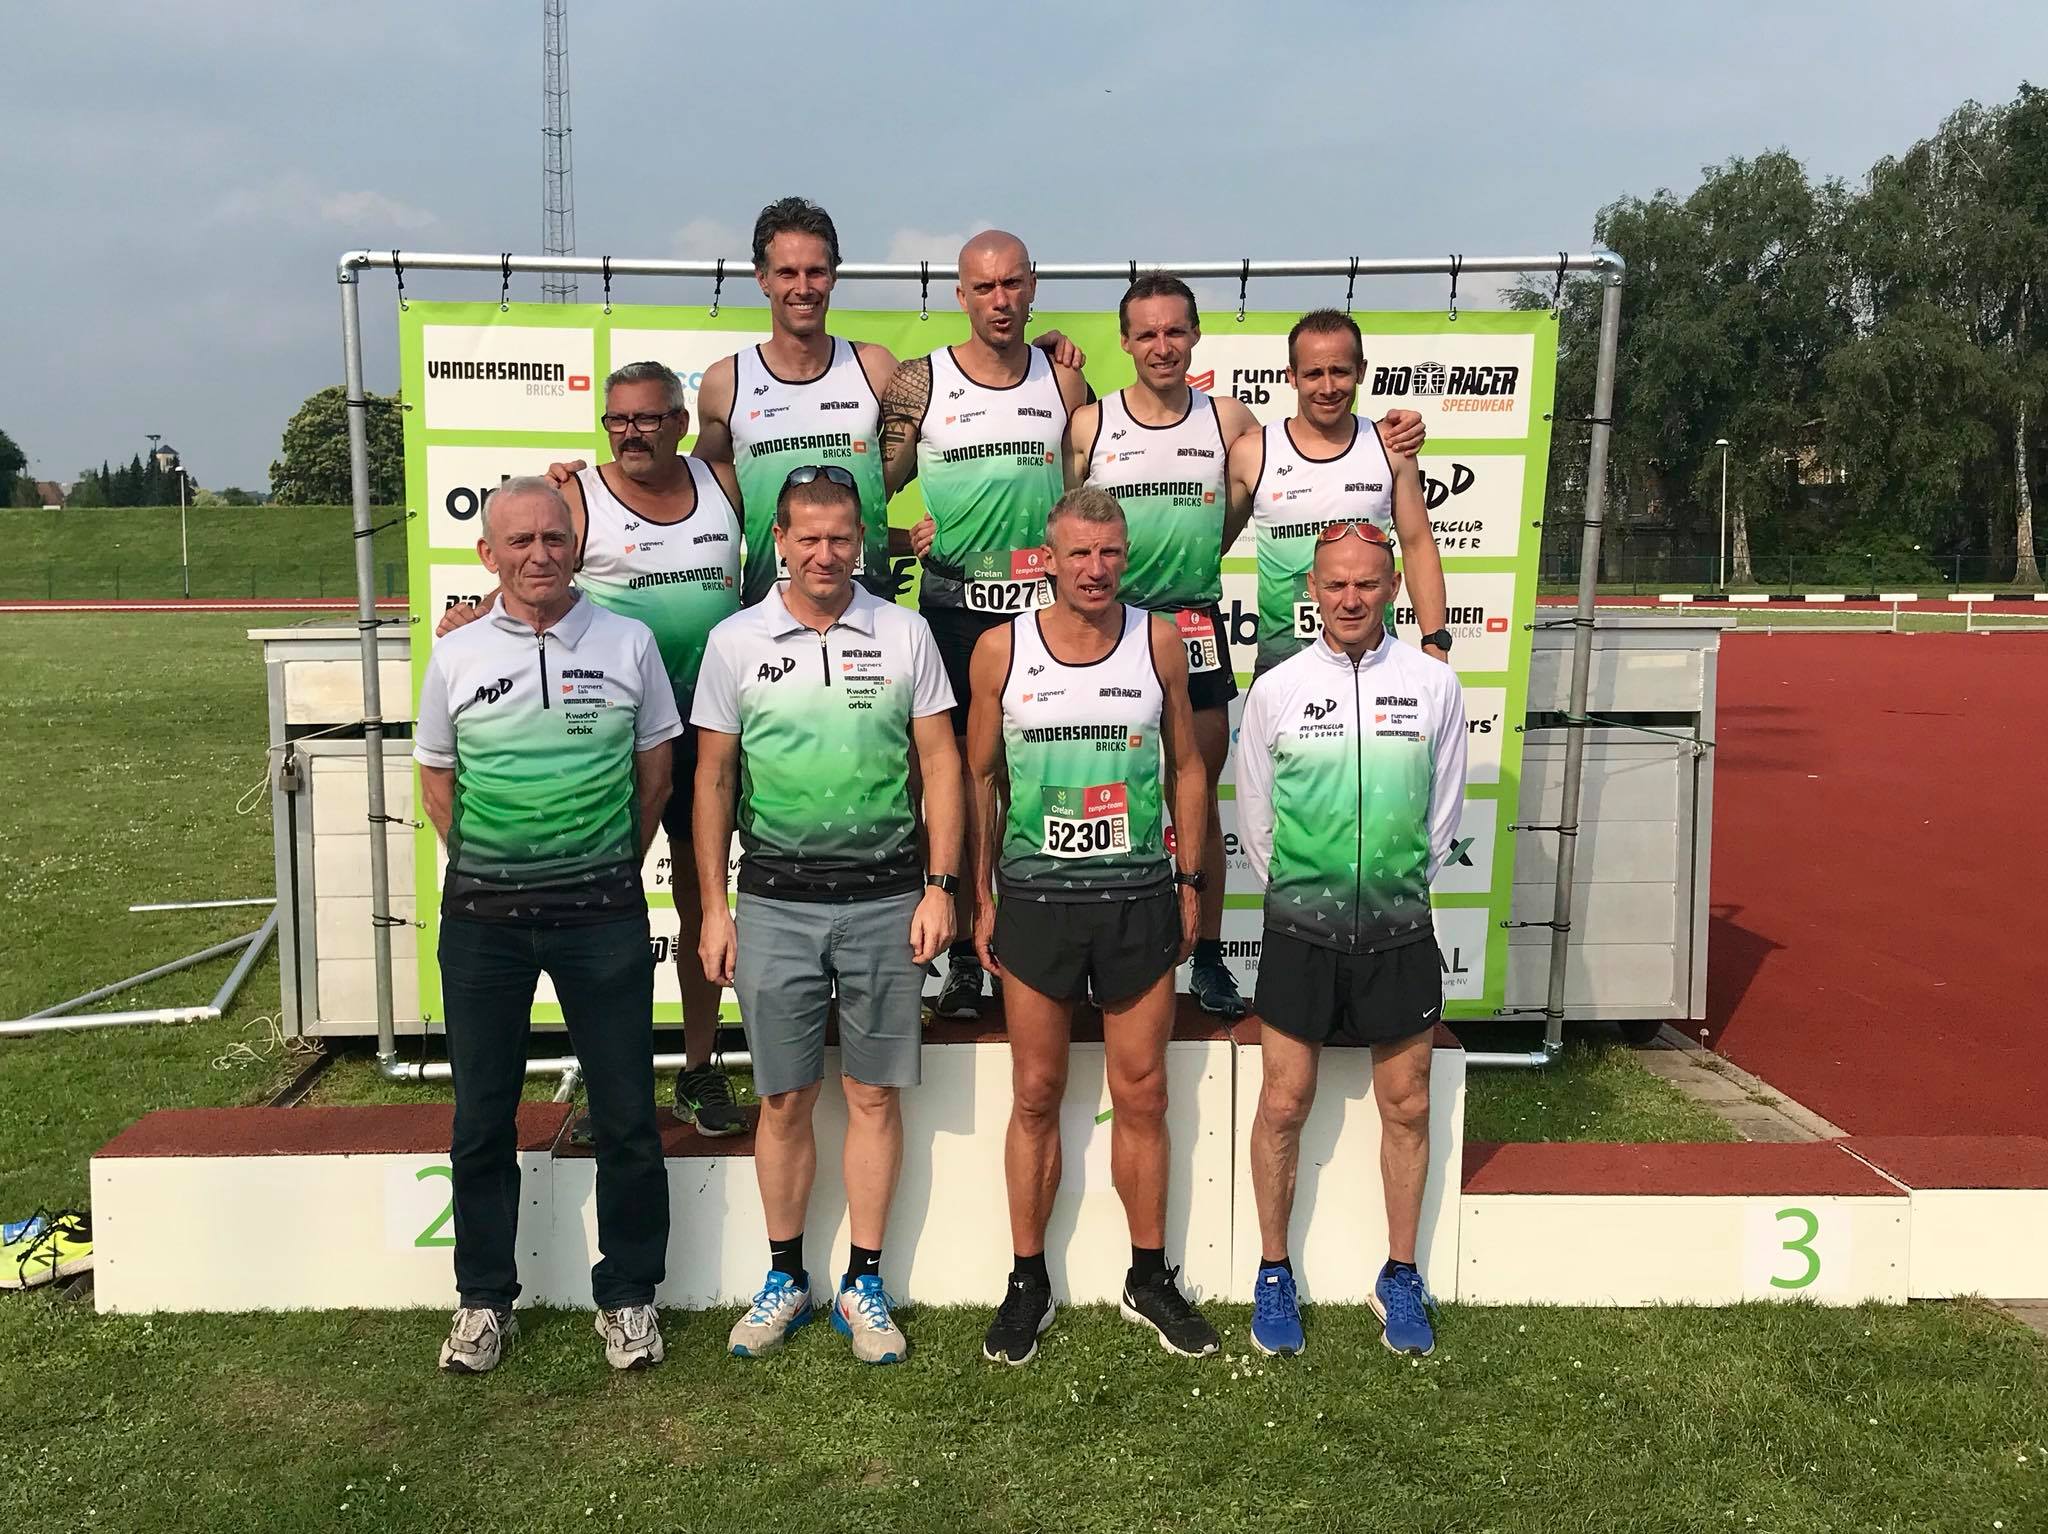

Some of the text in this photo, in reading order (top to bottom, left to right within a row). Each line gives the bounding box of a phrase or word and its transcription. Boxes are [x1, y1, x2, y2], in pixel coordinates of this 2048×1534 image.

[428, 361, 564, 382] VANDERSANDEN
[1447, 366, 1519, 396] RACER
[526, 384, 565, 397] BRICKS
[753, 385, 769, 396] ADD
[949, 388, 965, 400] ADD
[1232, 385, 1271, 405] lab
[1441, 399, 1514, 412] SPEEDWEAR
[1111, 430, 1127, 440] ADD
[750, 432, 851, 458] VANDERSANDEN
[823, 448, 852, 459] BRICKS
[943, 441, 1045, 463] VANDERSANDEN
[1016, 456, 1044, 467] BRICKS
[1277, 465, 1293, 476] ADD
[1105, 482, 1203, 500] ANDERSANDEN
[1173, 498, 1202, 508] BRICKS
[629, 567, 724, 590] VANDERSANDEN
[974, 570, 1003, 578] Crelan
[702, 582, 725, 591] BRICKS
[1039, 580, 1050, 605] 2018
[970, 582, 1036, 610] 6027
[1204, 640, 1216, 666] 2018
[757, 657, 796, 683] ADD
[1028, 664, 1045, 676] ADD
[474, 678, 513, 704] ADD
[848, 700, 872, 710] orbix
[1304, 698, 1337, 720] ADD
[567, 726, 593, 735] orbix
[1022, 725, 1128, 744] VANDERSANDEN
[1096, 742, 1126, 752] BRICKS
[1052, 805, 1074, 816] Crelan
[1049, 820, 1110, 852] 5230
[1114, 818, 1124, 846] 2018
[413, 1165, 458, 1247] 2
[1769, 1207, 1822, 1290] 3
